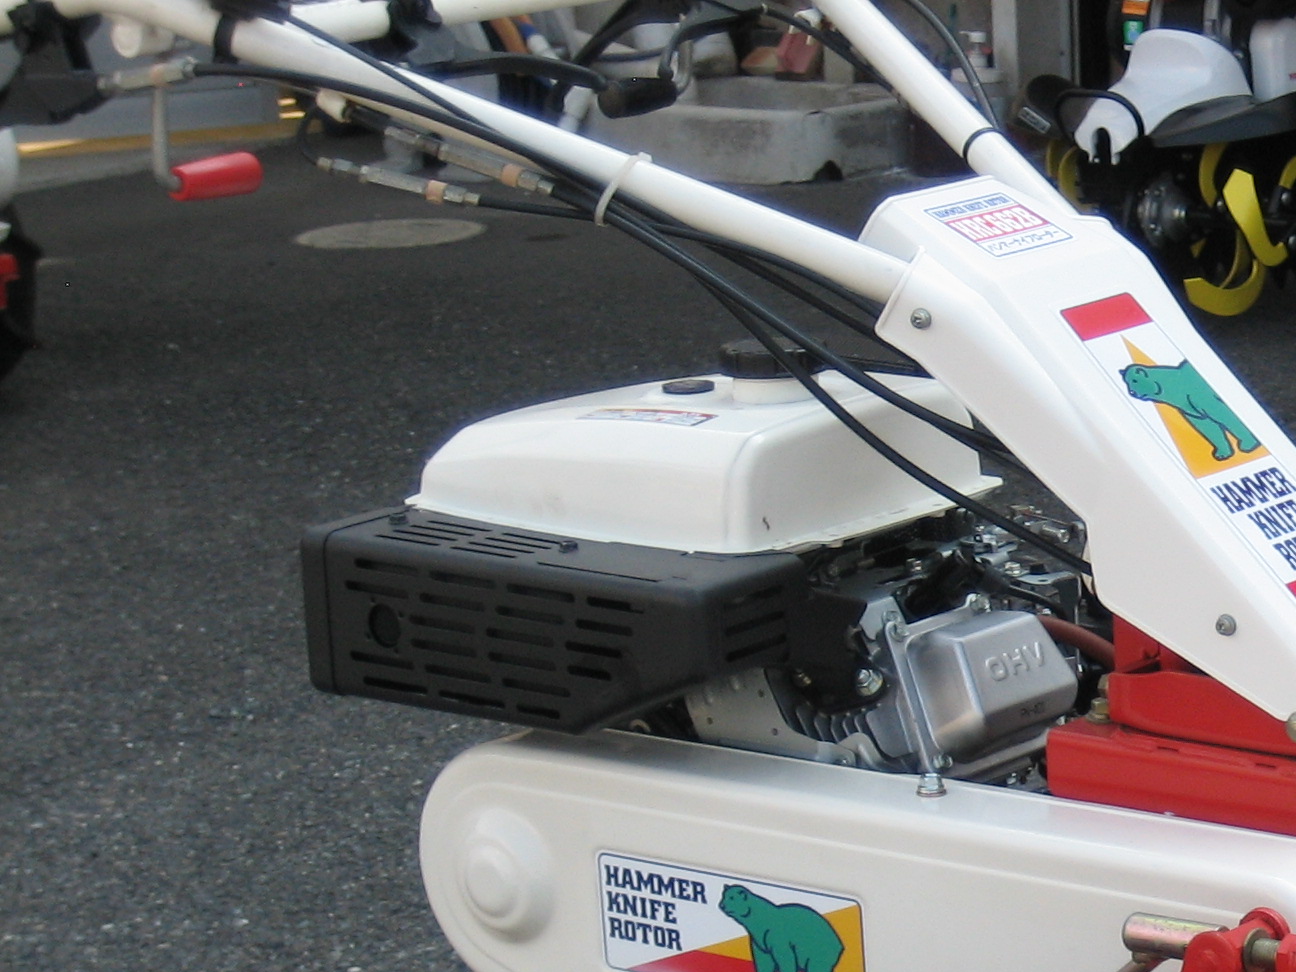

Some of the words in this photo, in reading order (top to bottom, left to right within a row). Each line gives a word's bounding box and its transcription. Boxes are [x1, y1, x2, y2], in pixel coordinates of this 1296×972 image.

[948, 206, 1044, 240] HRC662B
[985, 641, 1044, 682] OHV
[604, 864, 708, 904] HAMMER
[606, 891, 677, 924] KNIFE
[608, 916, 683, 951] ROTOR
